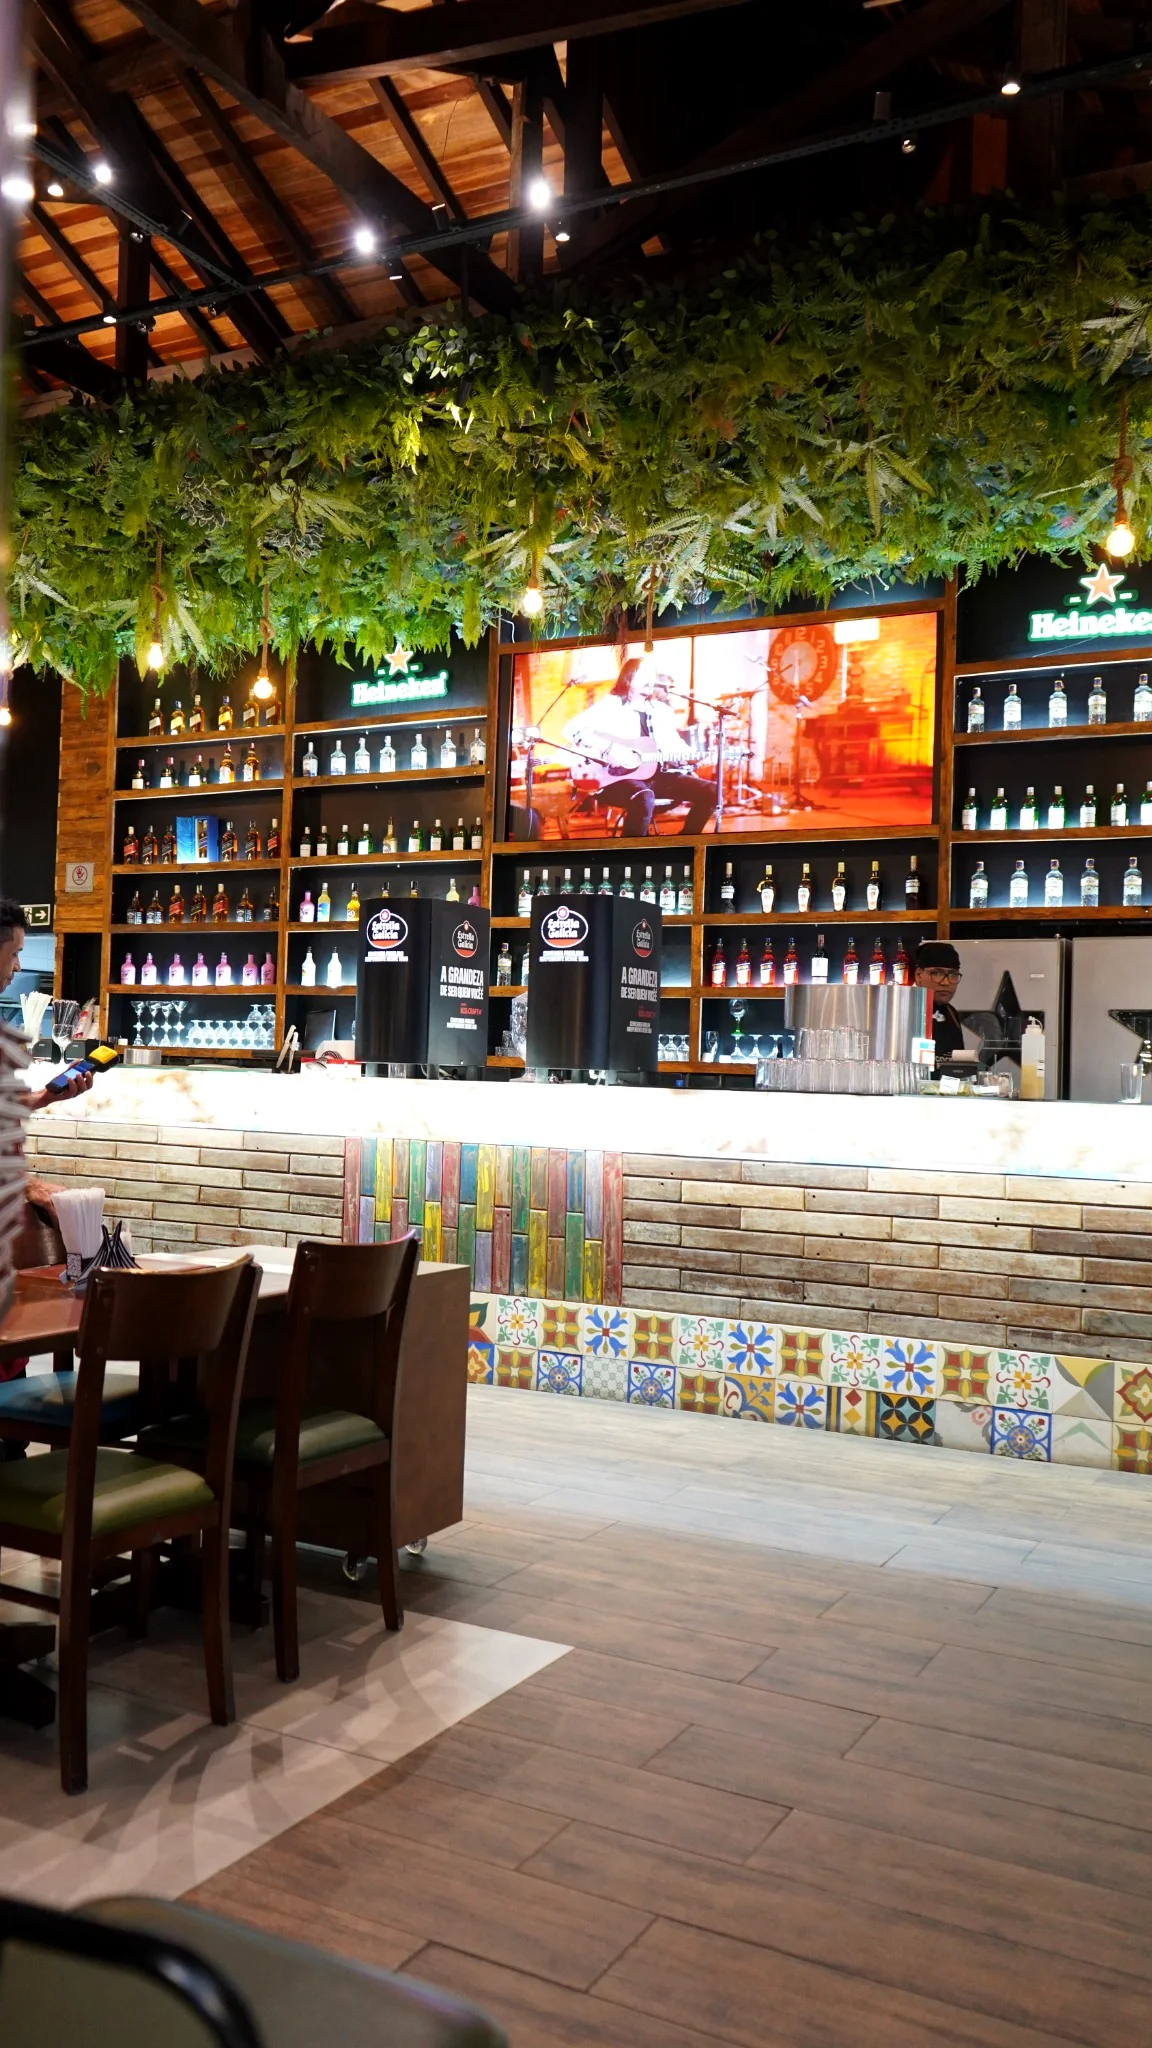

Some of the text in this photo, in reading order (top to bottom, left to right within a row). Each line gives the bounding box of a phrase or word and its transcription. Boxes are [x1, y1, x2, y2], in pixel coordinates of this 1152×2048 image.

[353, 676, 445, 704] Heineken
[372, 920, 400, 931] Estrella
[547, 918, 580, 929] Estrella
[372, 930, 398, 939] Galicia
[457, 930, 474, 941] Estrella
[548, 928, 578, 938] Galicia
[636, 930, 651, 939] Estrella
[457, 940, 474, 949] Galicia
[637, 939, 650, 949] Galicia
[440, 966, 484, 987] A GRANDEZA
[621, 966, 657, 988] A GRANDEZA
[440, 985, 447, 996] DE
[448, 985, 457, 997] SER
[621, 987, 627, 998] DE
[628, 987, 636, 999] SER
